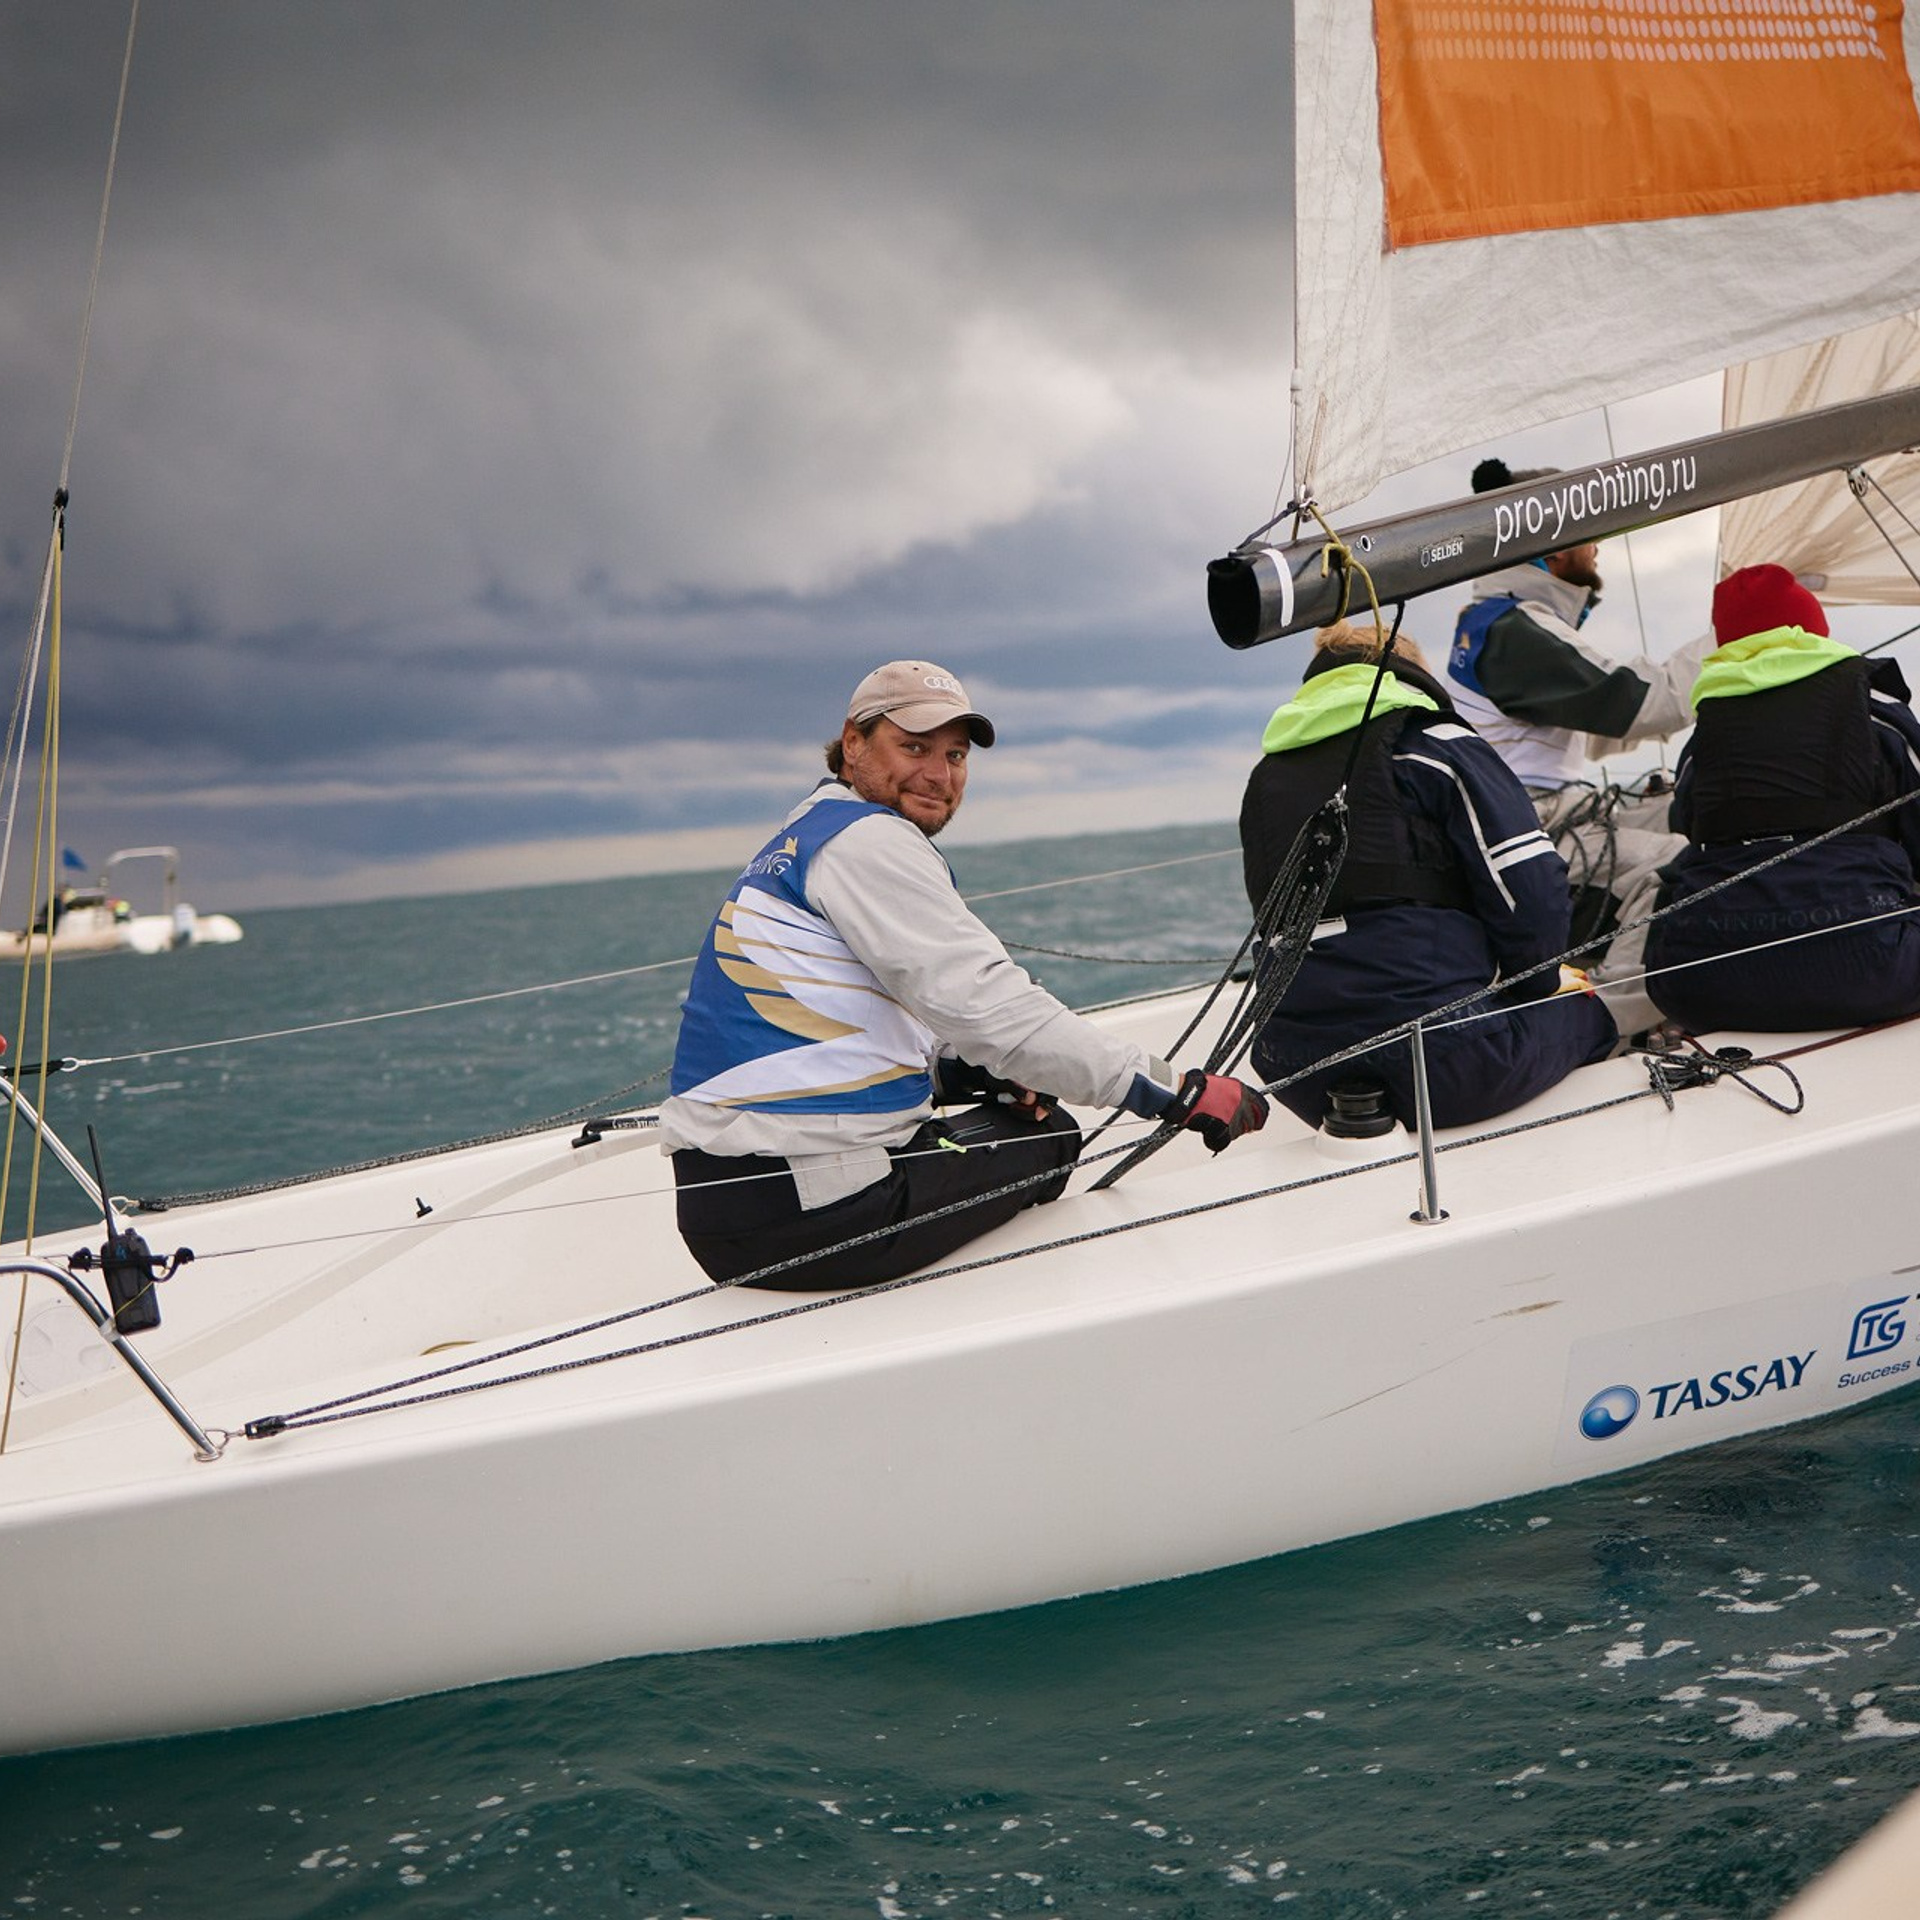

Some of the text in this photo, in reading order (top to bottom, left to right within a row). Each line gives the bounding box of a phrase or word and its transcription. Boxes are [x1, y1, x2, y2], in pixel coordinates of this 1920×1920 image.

[1493, 455, 1697, 557] pro-yachting.ru
[1861, 1309, 1907, 1348] TG
[1647, 1350, 1818, 1420] TASSAY
[1837, 1358, 1911, 1389] Success
